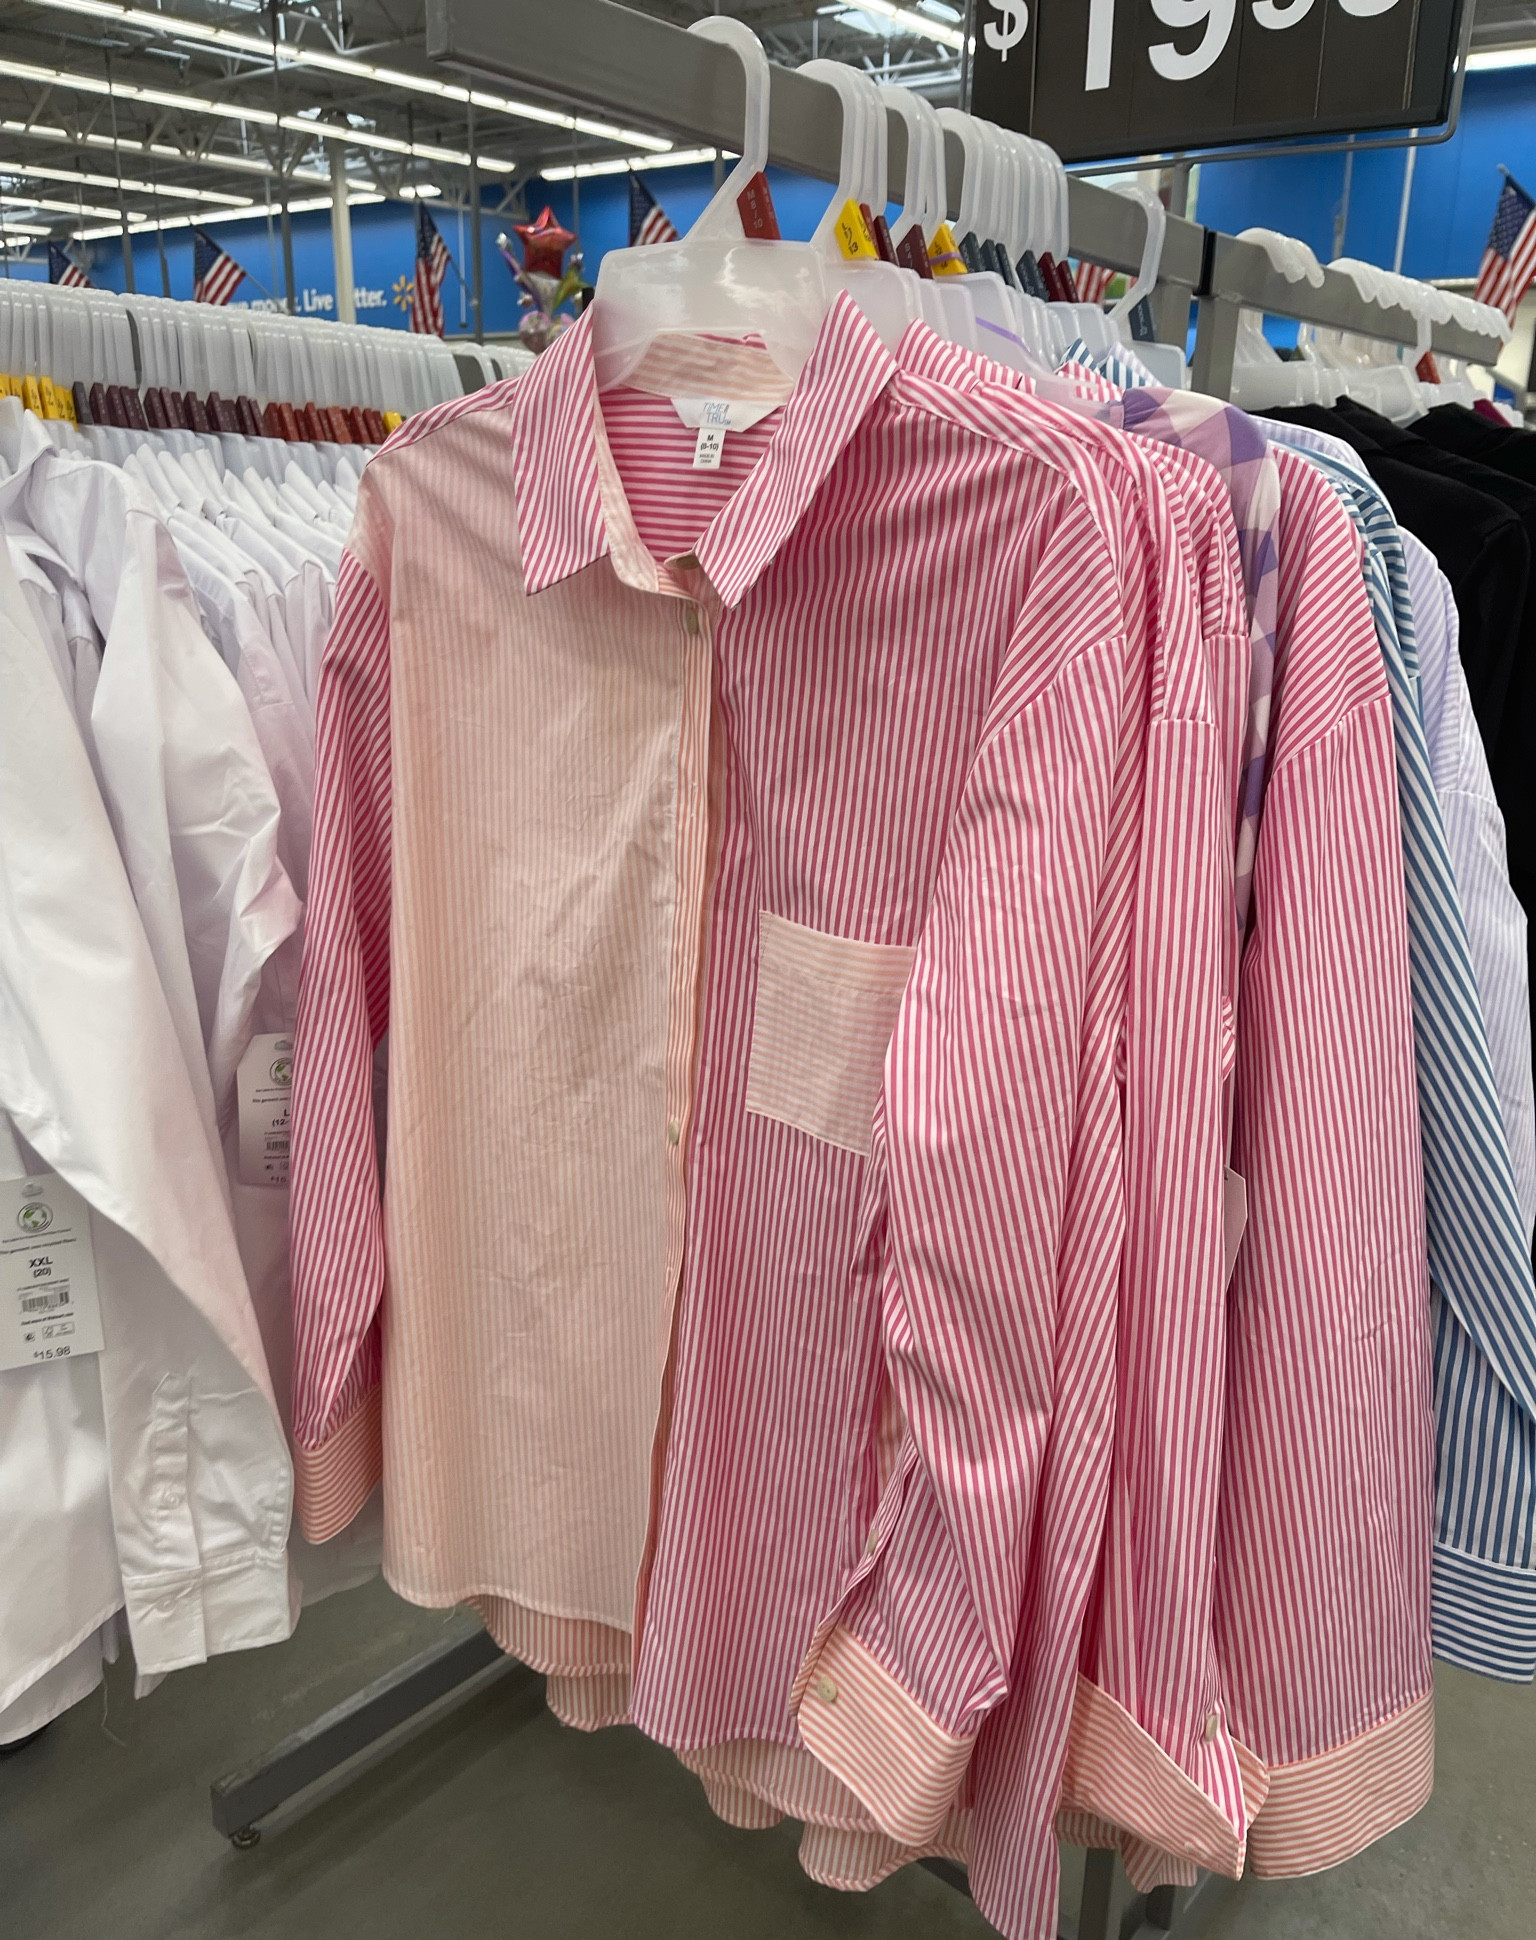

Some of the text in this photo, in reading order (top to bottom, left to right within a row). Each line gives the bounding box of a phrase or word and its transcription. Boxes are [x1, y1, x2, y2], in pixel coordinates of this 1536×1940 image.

[303, 288, 334, 312] Live
[353, 286, 388, 308] tter.
[283, 1108, 290, 1117] L
[29, 1256, 53, 1268] XXL
[33, 1267, 52, 1279] (20)
[34, 1345, 71, 1360] $15.98
